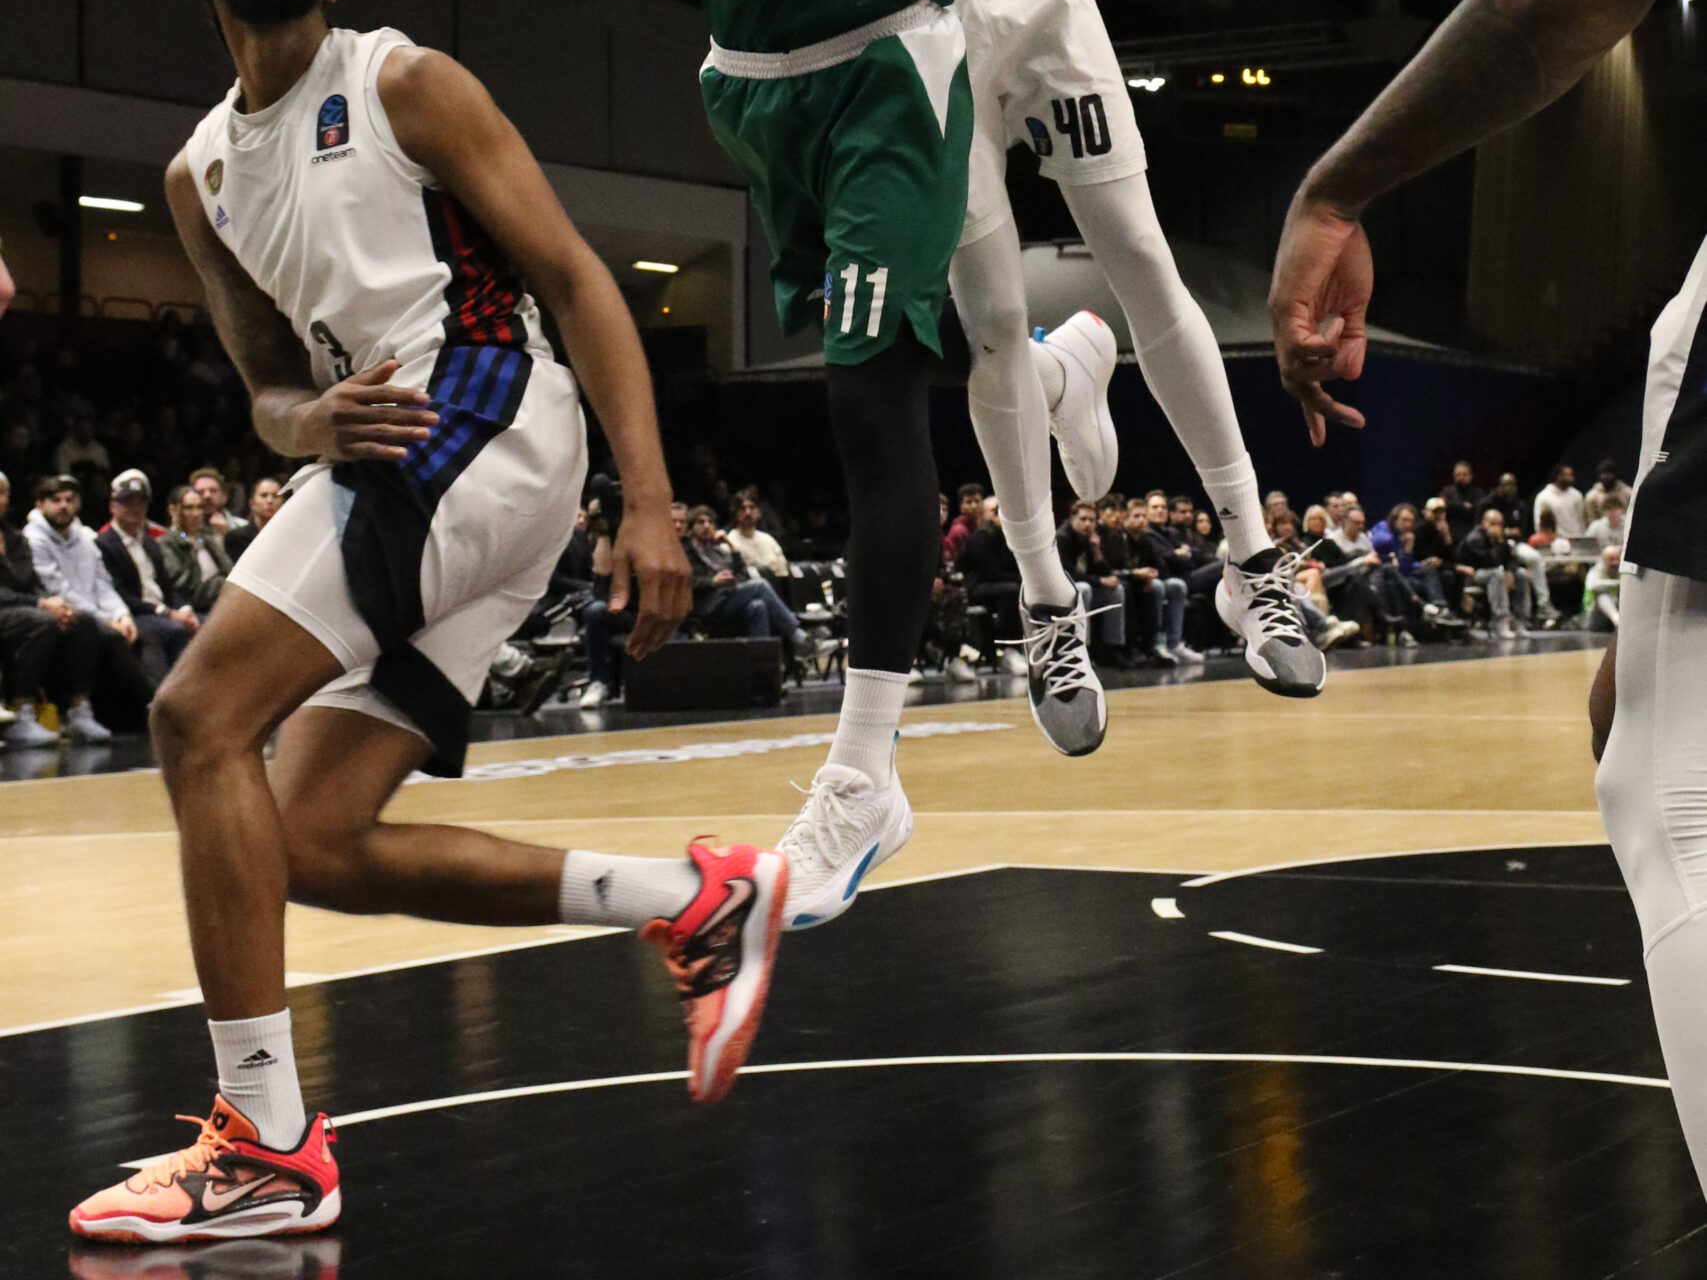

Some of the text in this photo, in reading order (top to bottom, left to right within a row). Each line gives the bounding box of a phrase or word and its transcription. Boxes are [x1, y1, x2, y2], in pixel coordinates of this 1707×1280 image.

[311, 147, 357, 165] oneteam
[1051, 93, 1113, 160] 40
[840, 262, 889, 338] 11
